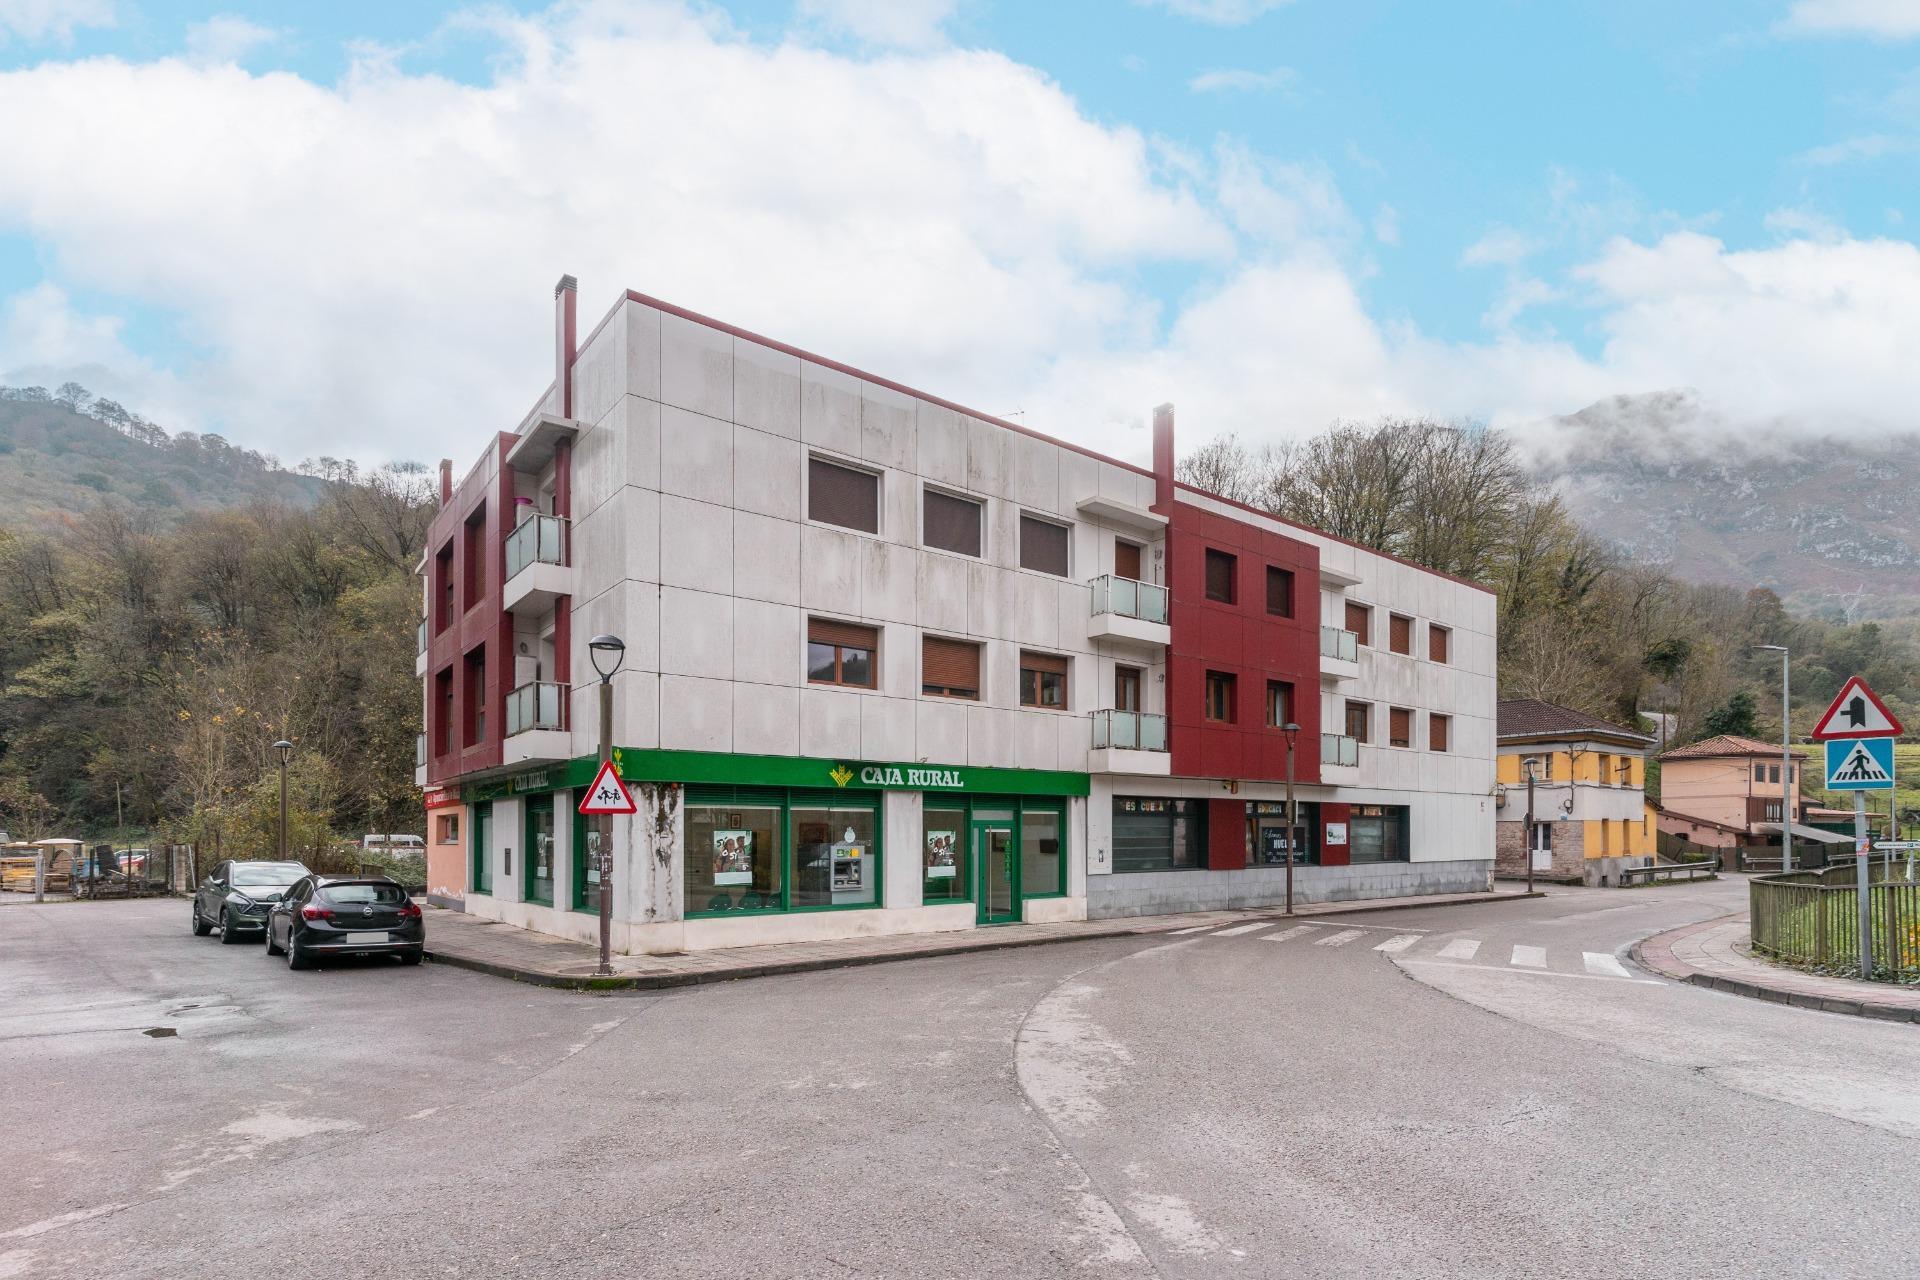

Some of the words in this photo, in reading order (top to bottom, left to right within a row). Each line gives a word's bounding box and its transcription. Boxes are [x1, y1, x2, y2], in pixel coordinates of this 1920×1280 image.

[861, 766, 904, 786] CAJA
[907, 769, 964, 787] RURAL
[1273, 839, 1297, 849] HUELA
